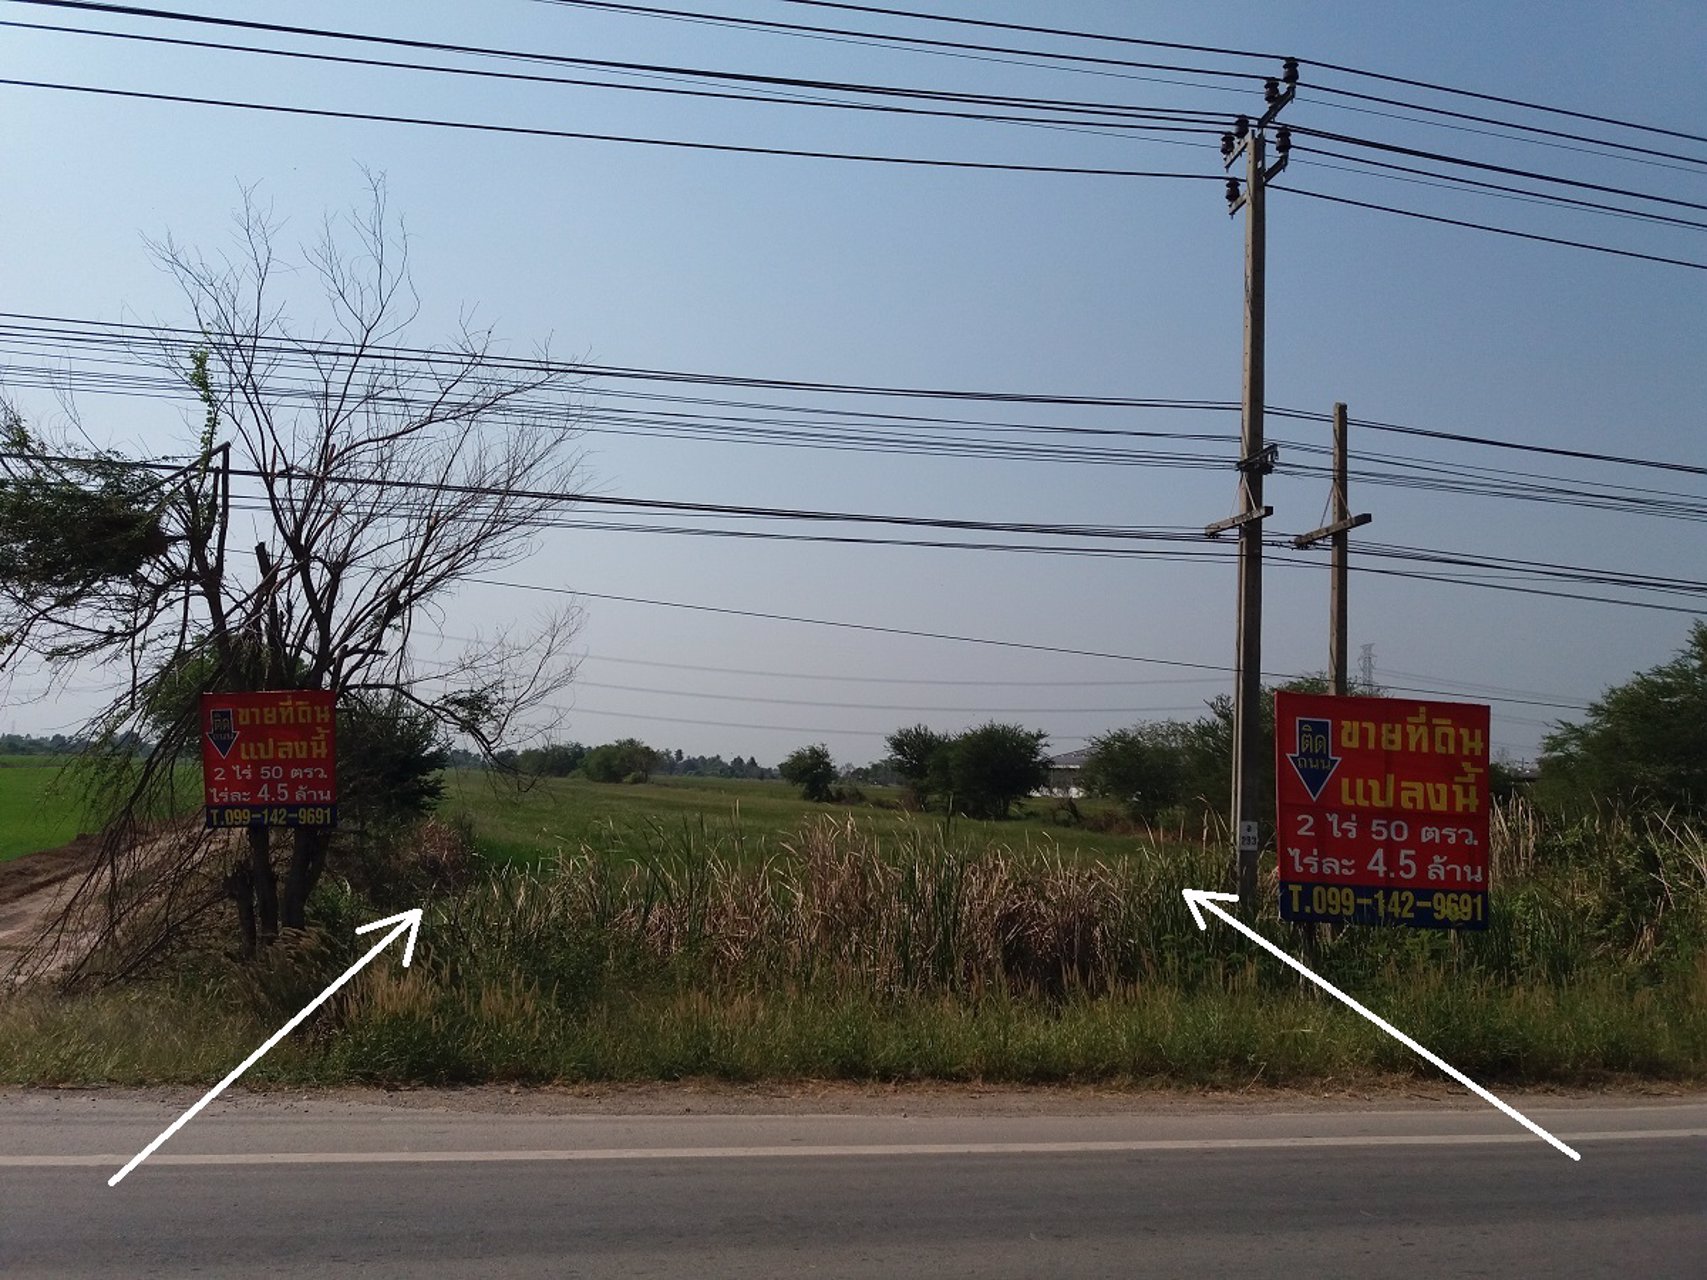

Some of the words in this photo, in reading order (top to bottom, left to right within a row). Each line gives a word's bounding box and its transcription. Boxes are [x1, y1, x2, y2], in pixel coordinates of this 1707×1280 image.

[238, 696, 330, 725] ขายที่ดิน
[241, 726, 330, 759] แปลงนี้
[1301, 724, 1327, 754] ติด
[1340, 706, 1484, 756] ขายที่ดิน
[213, 767, 226, 780] 2
[232, 765, 253, 780] ไร่
[260, 766, 283, 779] 50
[1341, 761, 1484, 813] แปลงนี้
[209, 787, 251, 803] ไร่ละ
[257, 783, 288, 802] 4.5
[295, 785, 331, 801] ล้าน
[210, 808, 331, 826] T.099-142-9691
[1297, 815, 1315, 836] 2
[1326, 813, 1358, 839] ไร่
[1371, 820, 1409, 842] 50
[1421, 826, 1479, 845] ตรว.
[1287, 847, 1355, 875] ไร่ละ
[1367, 848, 1417, 879] 4.5
[1427, 855, 1483, 883] ล้าน
[1288, 884, 1483, 922] T.099-142-9691
